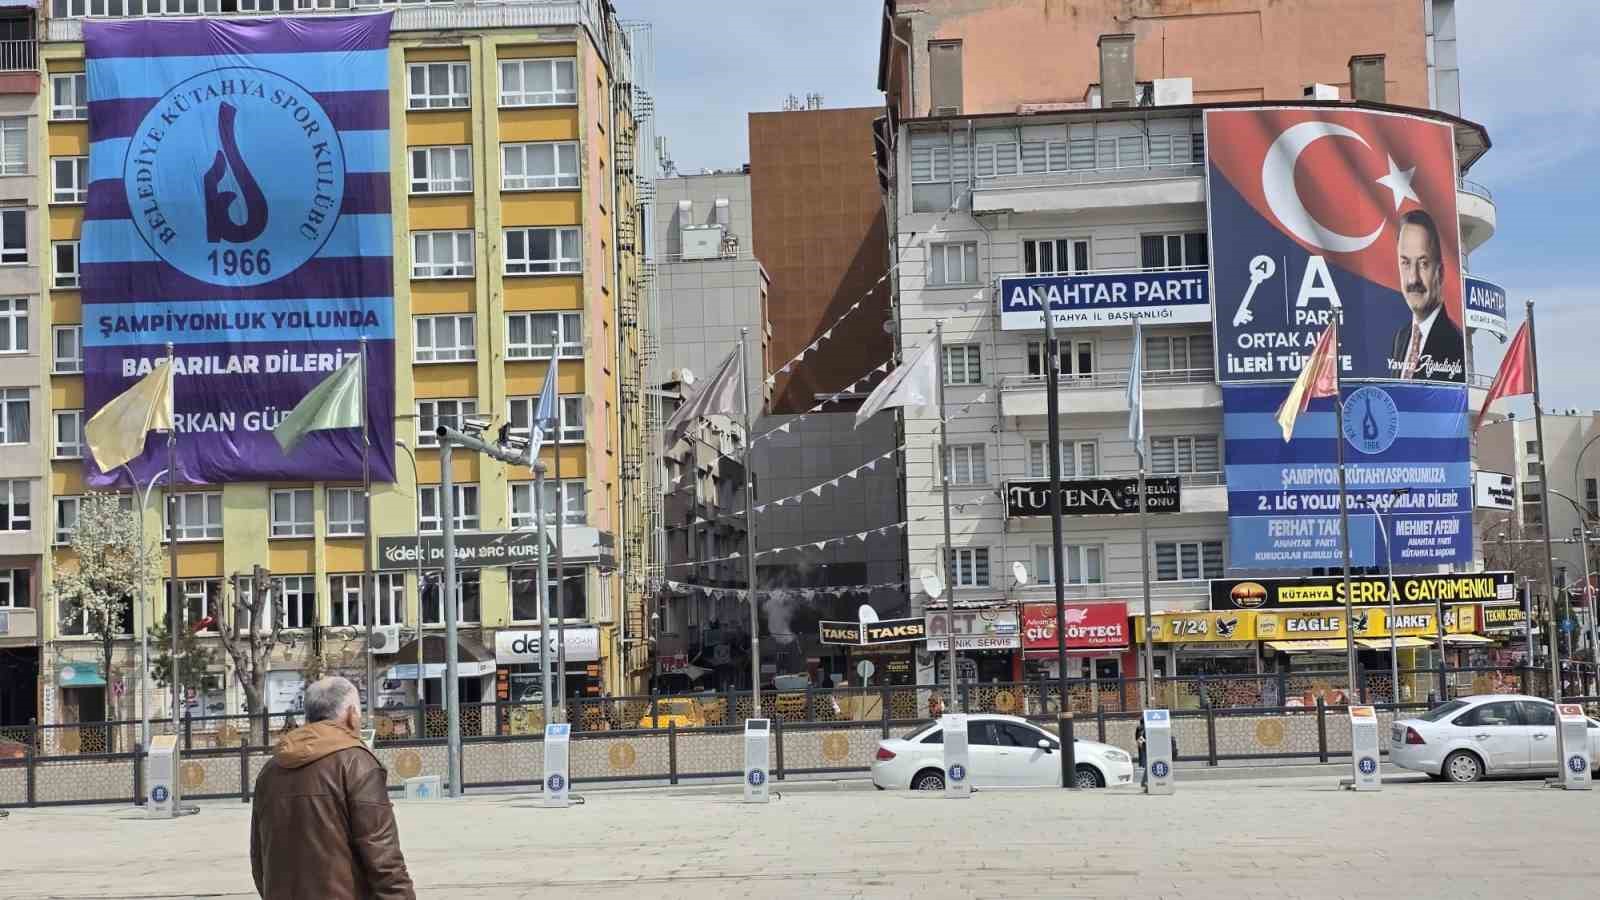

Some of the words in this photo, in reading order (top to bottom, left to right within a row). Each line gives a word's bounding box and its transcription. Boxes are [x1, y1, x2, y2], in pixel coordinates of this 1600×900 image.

[134, 126, 177, 246] BELEDİYE
[161, 79, 265, 126] KÜTAHYA
[270, 88, 320, 138] SPOR
[300, 139, 336, 242] KULÜBÜ
[207, 248, 272, 277] 1966
[1009, 283, 1127, 307] ANAHTAR
[99, 309, 266, 338] ŞAMPİYONLUK
[271, 309, 380, 330] YOLUNDA
[1238, 332, 1300, 349] ORTAK
[1227, 352, 1273, 373] İLERİ
[1281, 464, 1340, 489] ŞAMPİYON
[1258, 495, 1272, 511] 2.
[1275, 491, 1298, 511] LİG
[1427, 488, 1459, 508] DİLERİZ
[1268, 519, 1315, 537] FERHAT
[1396, 519, 1433, 536] MEHMET
[396, 545, 425, 560] dek
[1282, 591, 1329, 599] KÜTAHYA
[1335, 579, 1400, 603] SERRA
[1064, 624, 1123, 638] ÖFTECİ
[1172, 620, 1208, 634] 7/24
[1286, 618, 1340, 632] EAGLE
